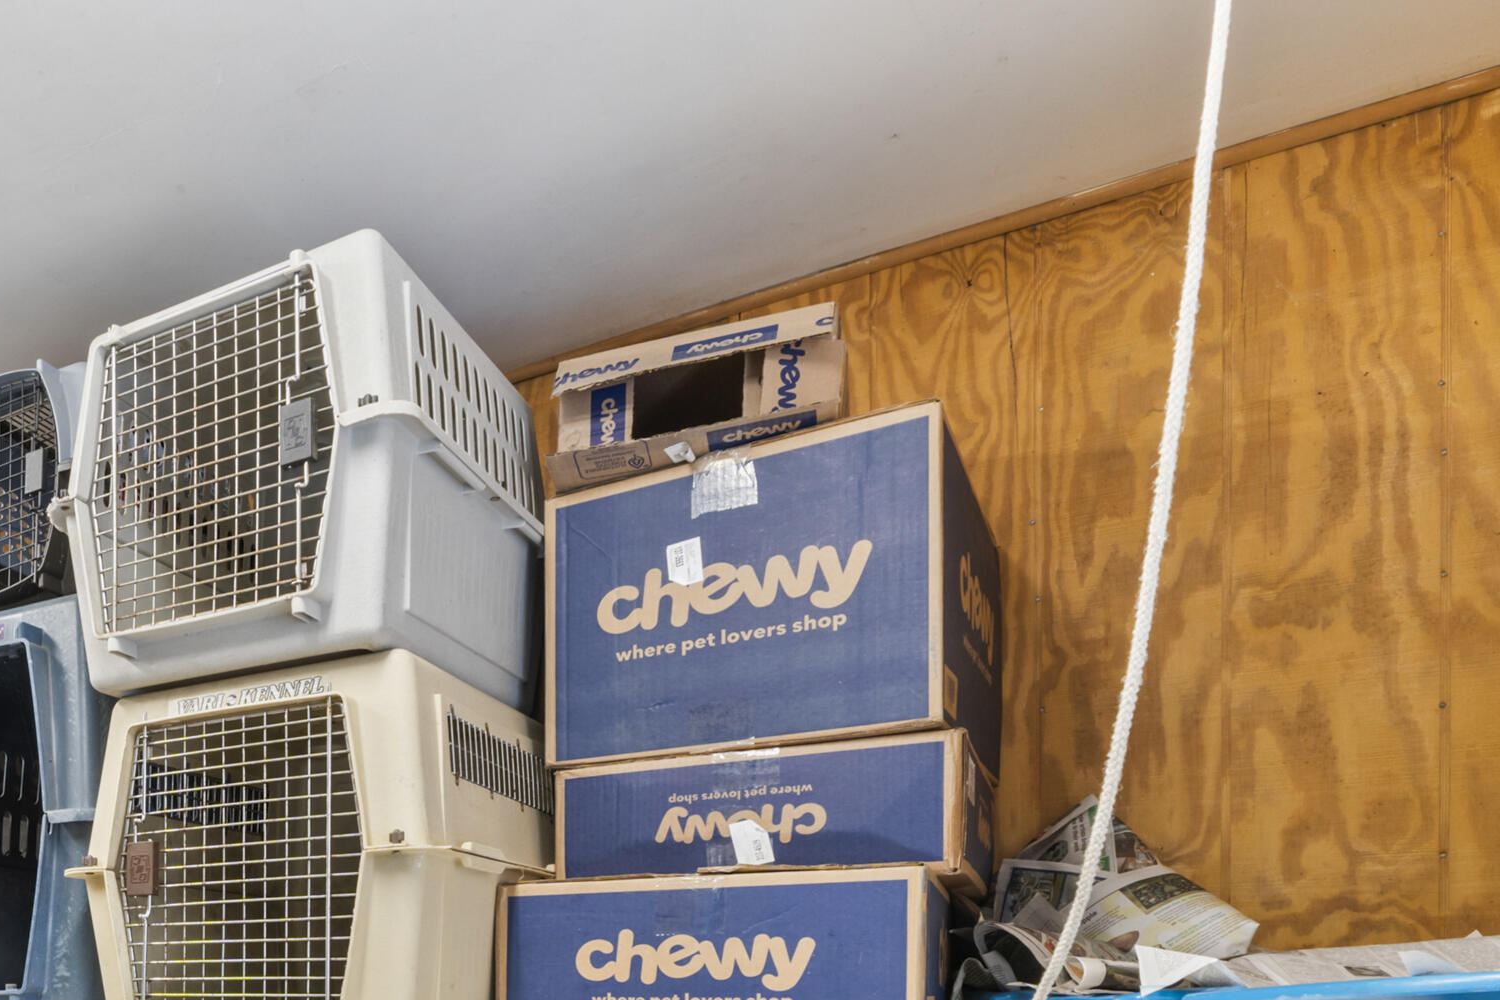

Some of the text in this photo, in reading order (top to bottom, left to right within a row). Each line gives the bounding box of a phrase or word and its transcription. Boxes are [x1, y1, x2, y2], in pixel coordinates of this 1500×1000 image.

[596, 539, 873, 635] chewy
[615, 613, 848, 663] where pet lovers shop
[238, 676, 325, 705] KENNEL
[668, 783, 813, 805] where pet lovers shop
[575, 928, 817, 992] chewy
